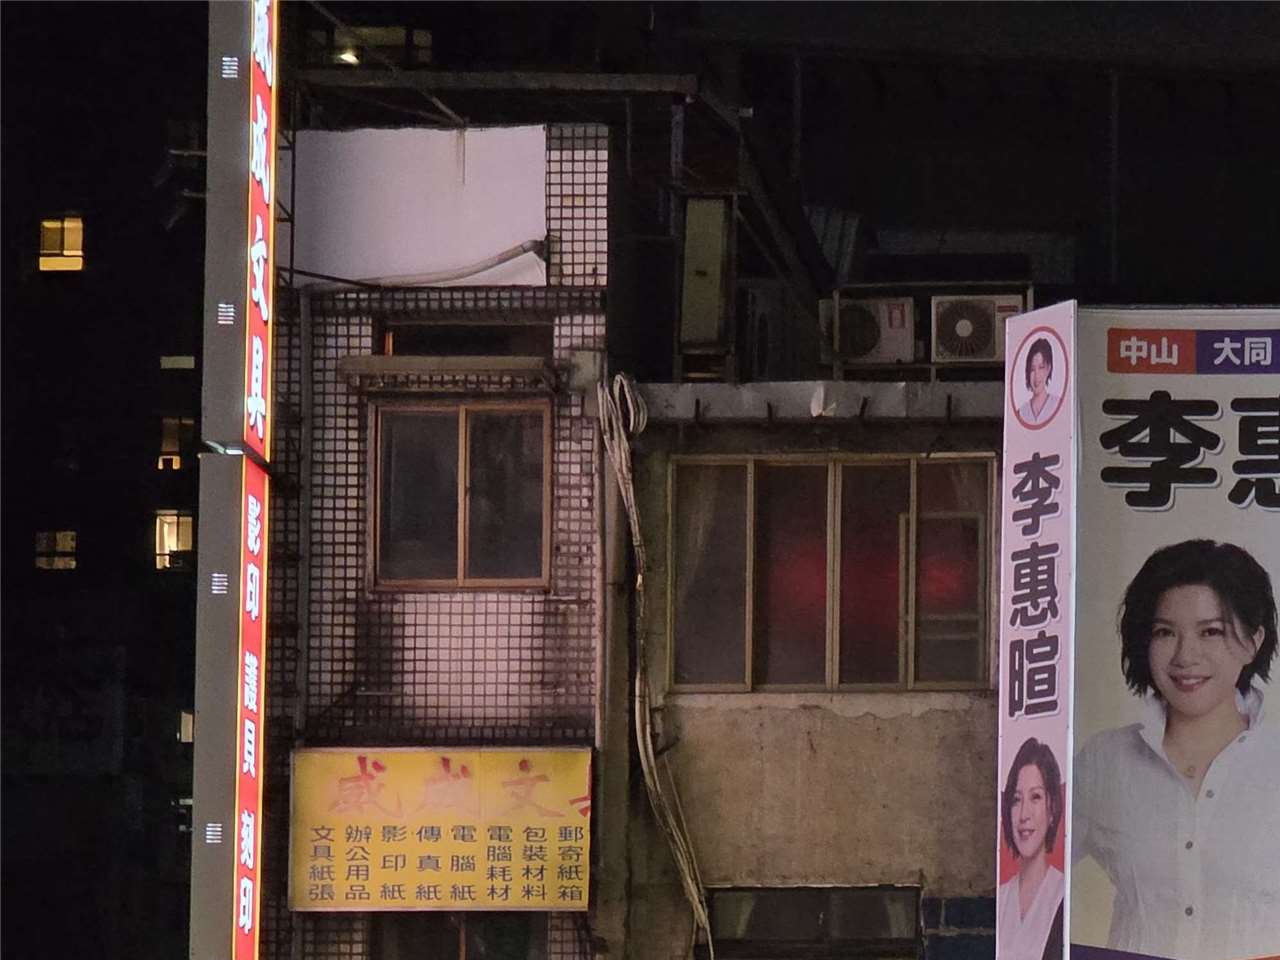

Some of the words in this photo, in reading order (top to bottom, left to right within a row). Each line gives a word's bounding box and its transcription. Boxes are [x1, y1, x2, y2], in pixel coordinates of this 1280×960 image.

[1119, 336, 1179, 366] 中山
[1213, 337, 1272, 366] 大同
[1008, 452, 1061, 718] 李惠暄
[308, 825, 335, 901] 文具紙張
[345, 825, 372, 901] 辦公用品
[381, 825, 407, 900] 影印紙
[415, 825, 441, 900] 傳真紙
[450, 825, 476, 900] 電腦紙
[487, 825, 512, 901] 電腦耗材
[522, 825, 547, 901] 包裝材料
[557, 825, 584, 901] 郵寄紙箱
